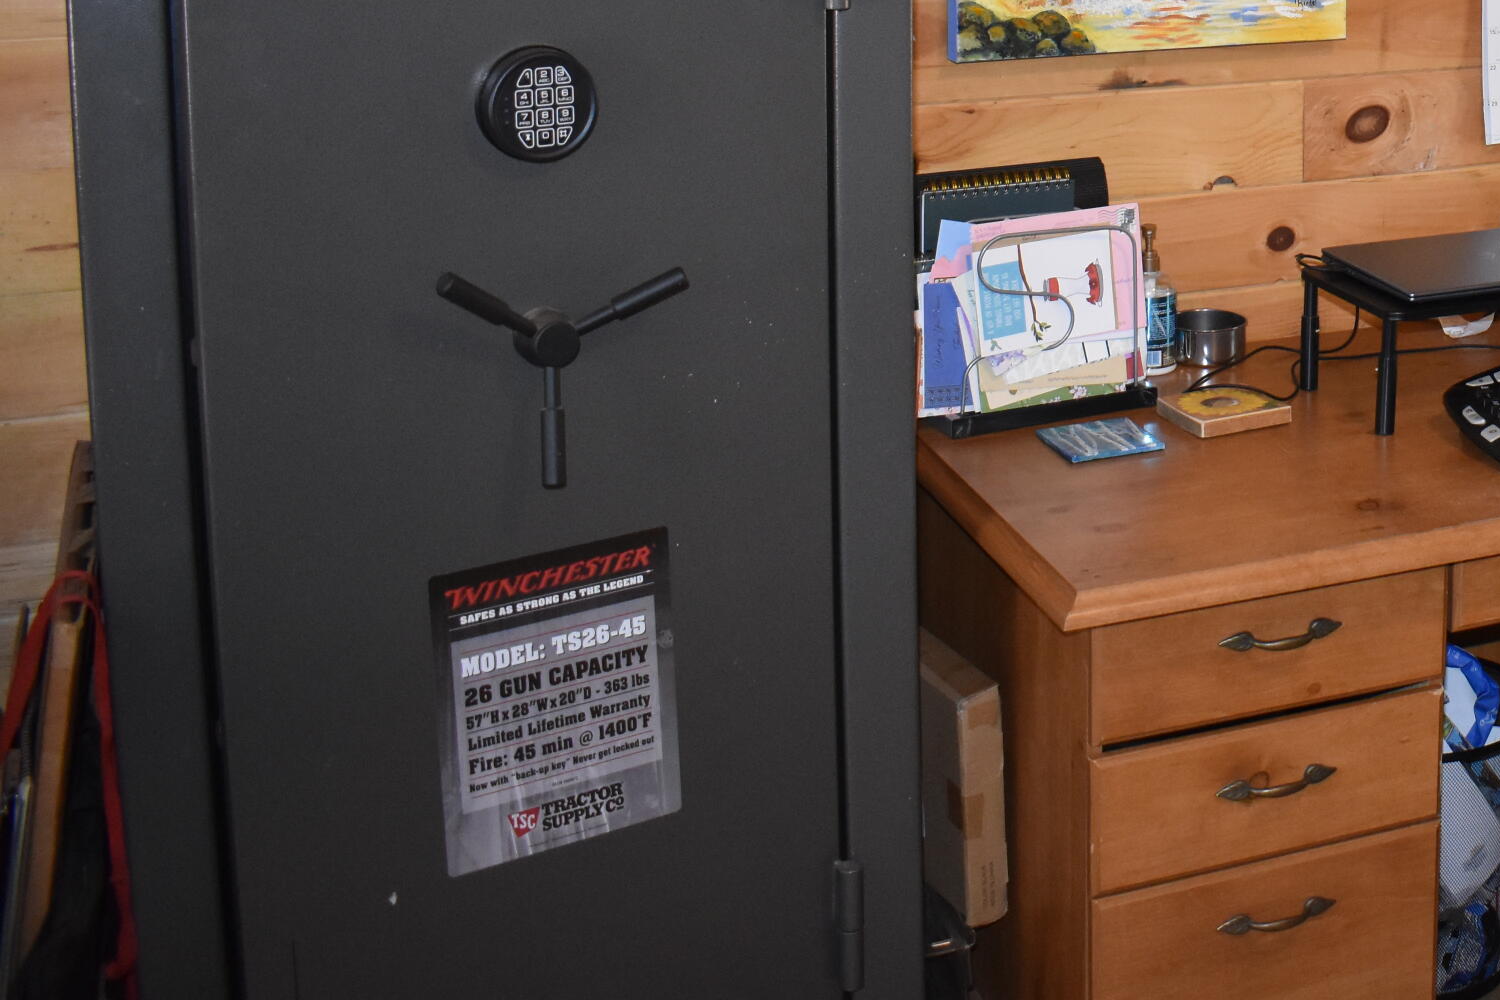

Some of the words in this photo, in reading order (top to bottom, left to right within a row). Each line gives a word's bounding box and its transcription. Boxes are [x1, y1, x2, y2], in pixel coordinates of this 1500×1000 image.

[444, 545, 651, 610] WINCHESTER
[460, 609, 496, 625] SAFES
[499, 604, 514, 616] AS
[517, 594, 560, 612] STRONG
[562, 590, 576, 601] AS
[580, 584, 600, 596] THE
[604, 574, 644, 590] LEGEND
[461, 642, 546, 678] MODEL:
[552, 615, 646, 655] TS26-45
[464, 684, 492, 707] 26
[500, 672, 542, 698] GUN
[549, 645, 648, 686] CAPACITY
[604, 679, 628, 695] 363
[632, 672, 650, 688] lbs
[468, 726, 523, 752] Limited
[528, 712, 586, 736] Lifetime
[590, 694, 650, 718] Warranty
[468, 754, 508, 775] Fire:
[514, 744, 536, 763] 45
[542, 736, 574, 756] min
[579, 730, 594, 746] @
[470, 782, 488, 793] Now
[490, 776, 509, 788] with
[573, 752, 596, 766] Never
[599, 748, 612, 760] get
[613, 739, 640, 755] locked
[642, 736, 654, 746] out
[511, 814, 536, 830] TSC
[542, 782, 624, 816] TRACTOR
[542, 804, 604, 832] SUPPLY
